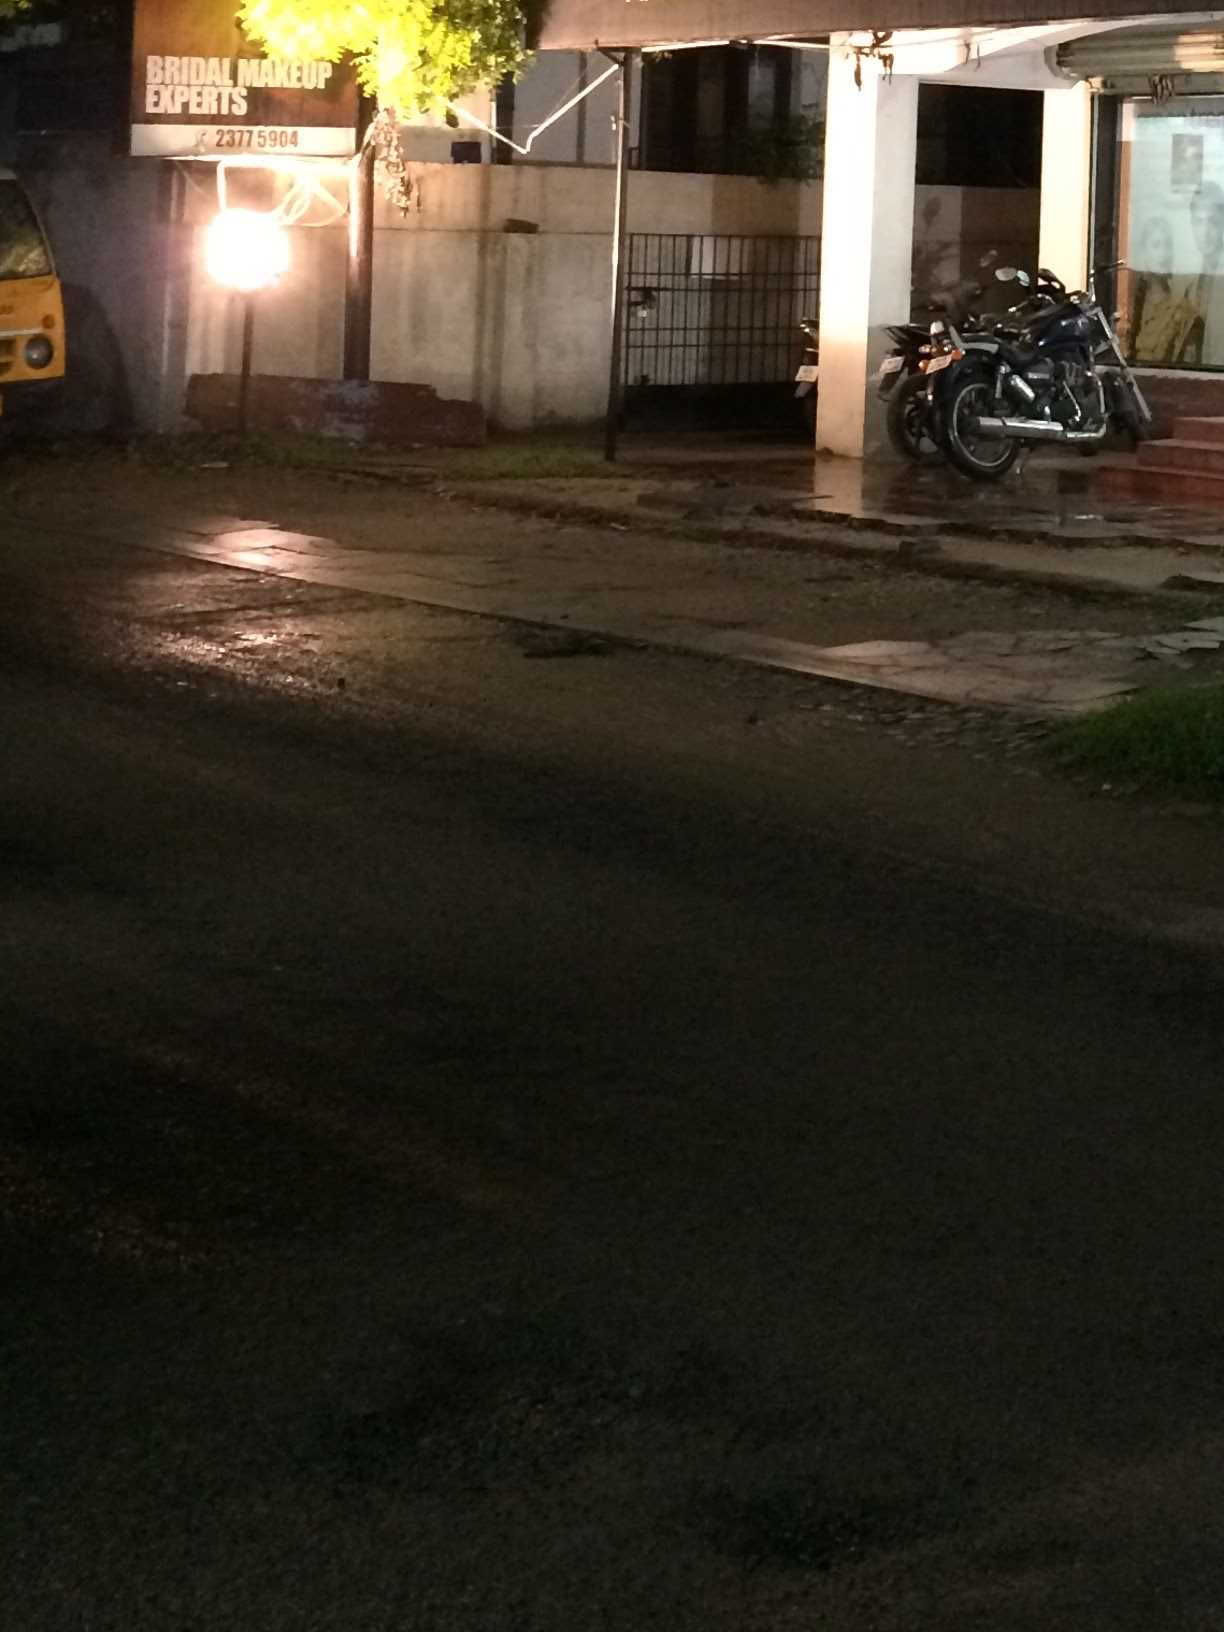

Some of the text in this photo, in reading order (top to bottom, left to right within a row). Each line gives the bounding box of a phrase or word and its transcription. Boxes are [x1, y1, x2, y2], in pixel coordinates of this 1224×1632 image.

[146, 55, 333, 89] BRIDAL MAKEUP
[145, 85, 248, 116] EXPERTS
